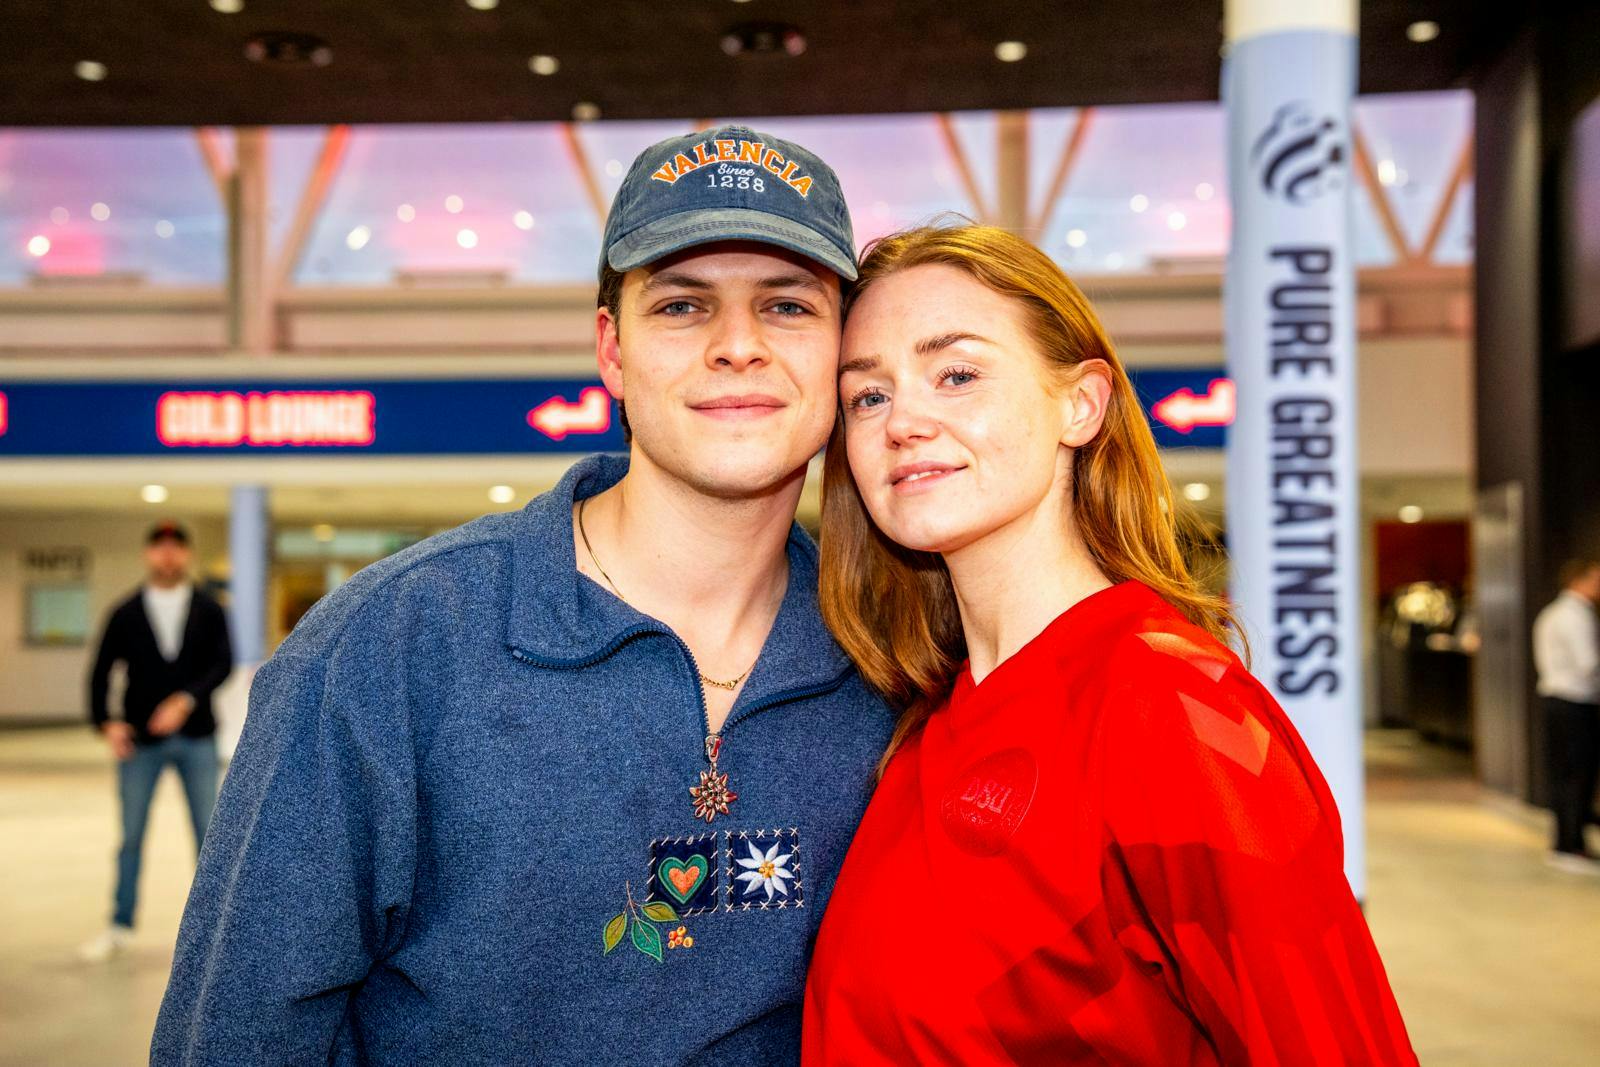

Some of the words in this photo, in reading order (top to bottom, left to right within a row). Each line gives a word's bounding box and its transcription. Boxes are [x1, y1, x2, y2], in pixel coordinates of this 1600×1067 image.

[651, 139, 814, 198] VALENCIA
[707, 174, 765, 193] 1238
[717, 163, 755, 177] Since
[1268, 247, 1334, 378] PURE
[1270, 396, 1338, 696] GREATNESS
